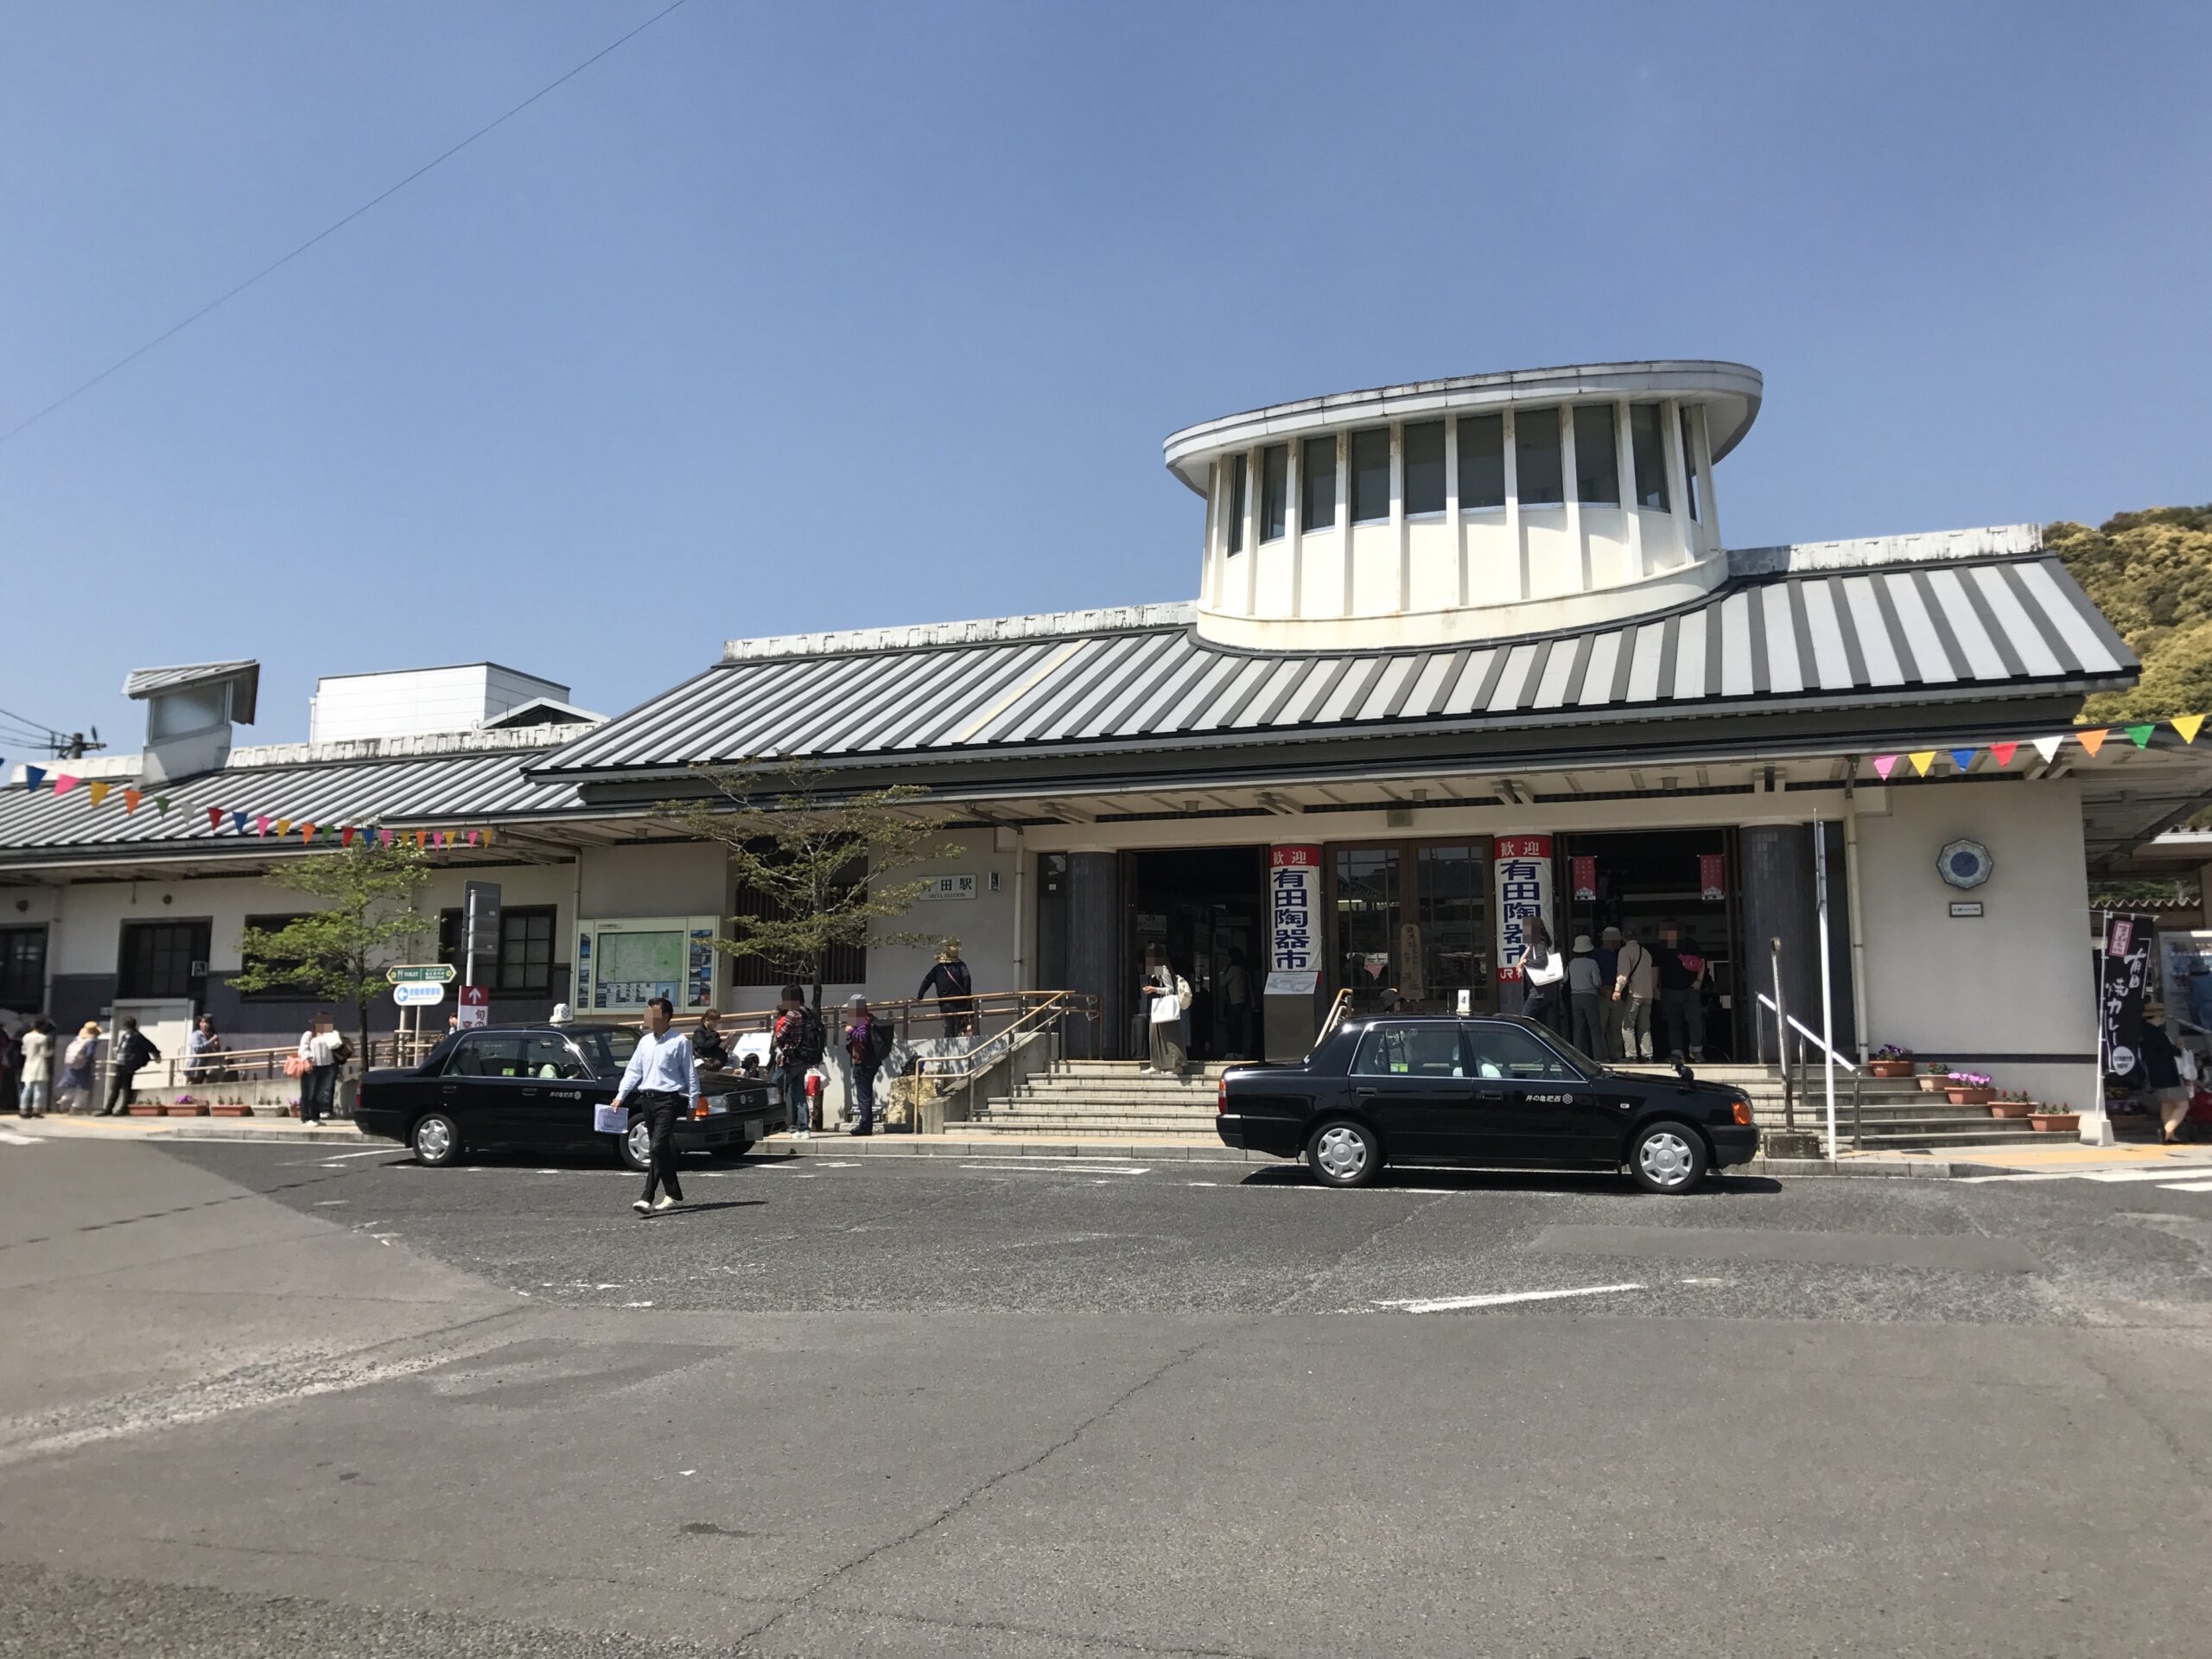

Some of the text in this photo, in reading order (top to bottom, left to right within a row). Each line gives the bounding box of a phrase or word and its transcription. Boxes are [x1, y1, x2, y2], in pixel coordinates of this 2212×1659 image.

[1500, 841, 1540, 856] 歓迎
[1273, 850, 1307, 865] 歓迎
[1273, 868, 1311, 969] 有田陶器市
[1460, 995, 1466, 1004] 4
